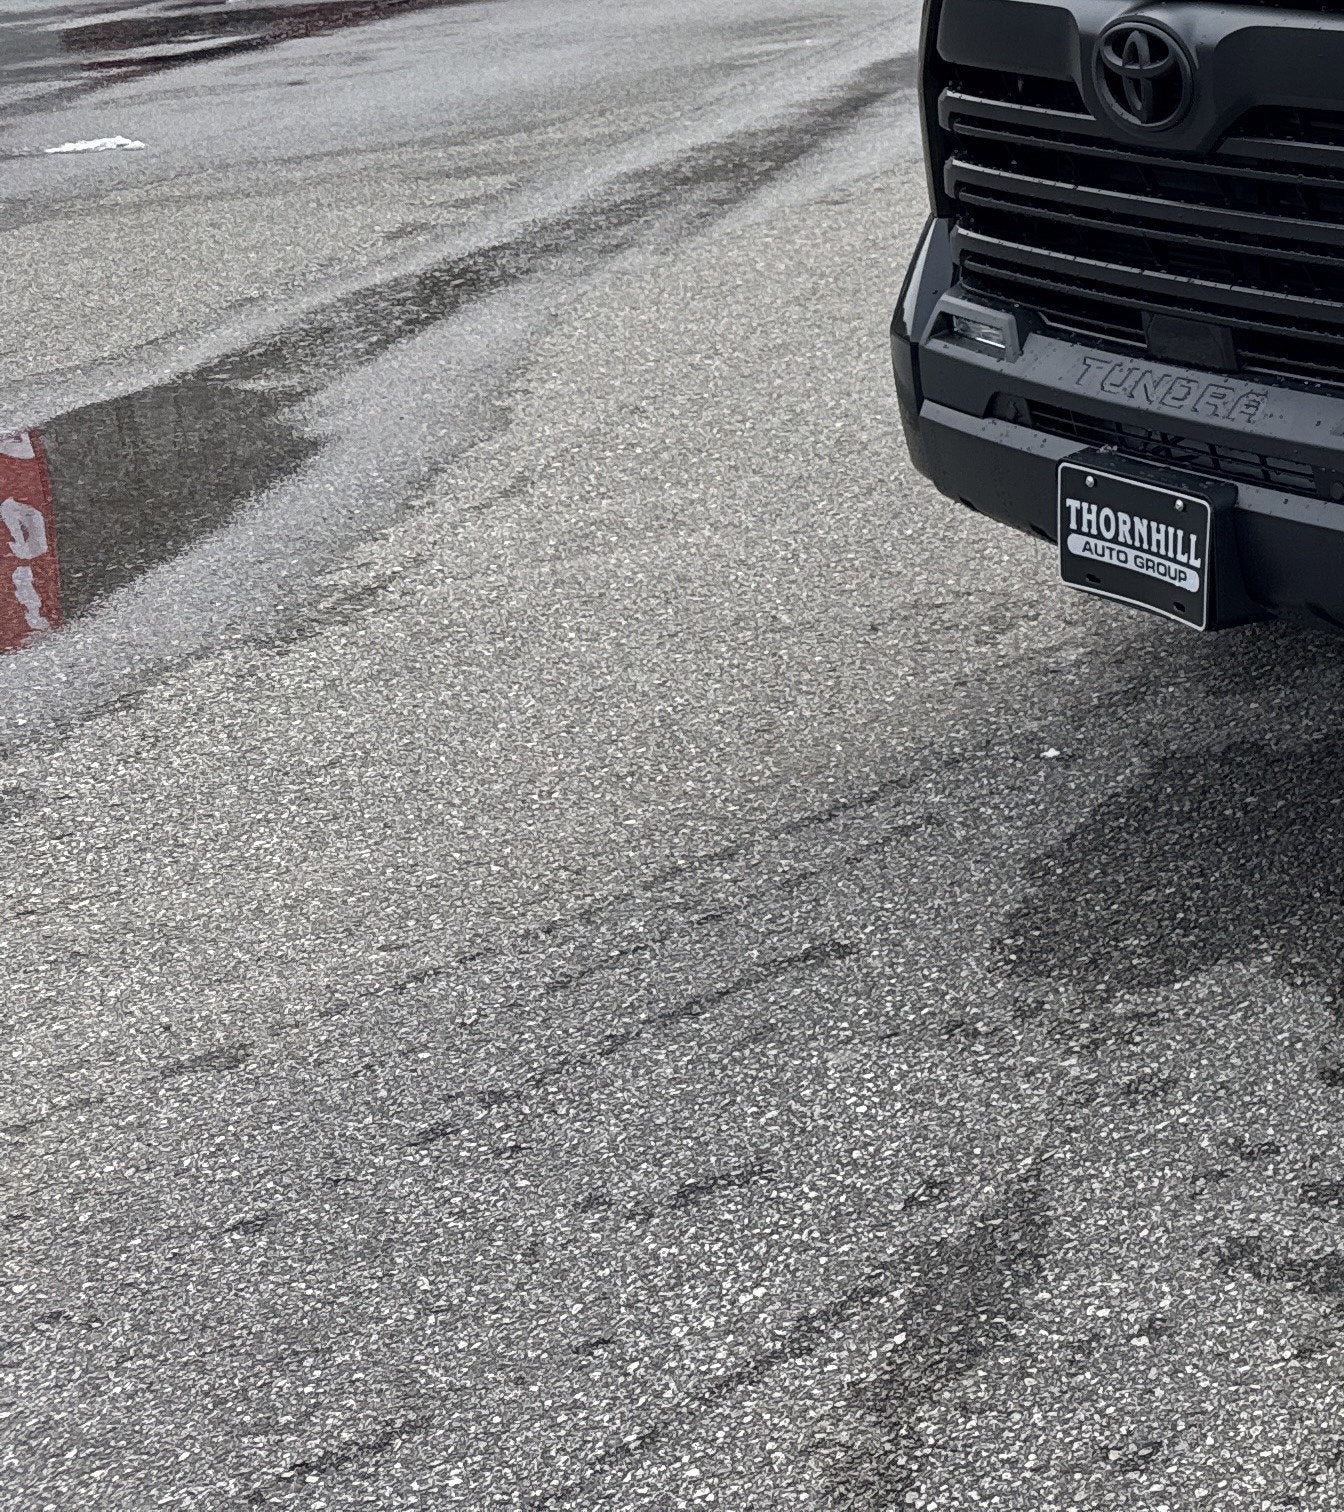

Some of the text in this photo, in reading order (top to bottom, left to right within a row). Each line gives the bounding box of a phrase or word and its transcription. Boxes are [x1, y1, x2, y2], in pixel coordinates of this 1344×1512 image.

[1076, 356, 1269, 424] TUNDRA
[1066, 498, 1201, 568] THORNHILL
[1082, 541, 1188, 584] AUTO GROUP
